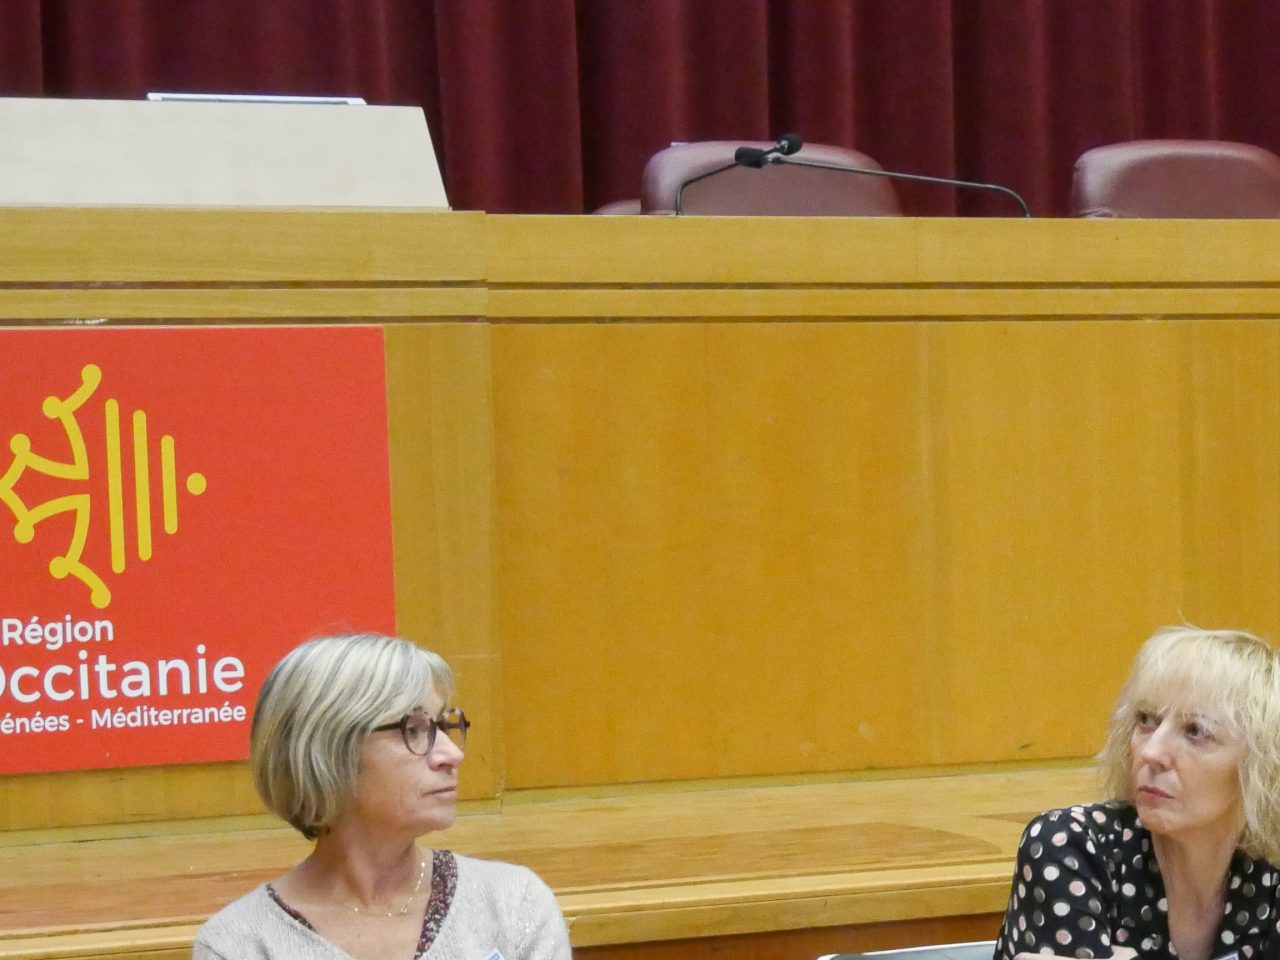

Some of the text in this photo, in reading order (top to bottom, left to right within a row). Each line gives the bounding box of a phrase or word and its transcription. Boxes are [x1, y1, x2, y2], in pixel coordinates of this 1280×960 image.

[2, 614, 114, 650] Région
[0, 644, 246, 703] ccitanie
[0, 711, 70, 734] énées
[91, 703, 247, 729] Méditerranée
